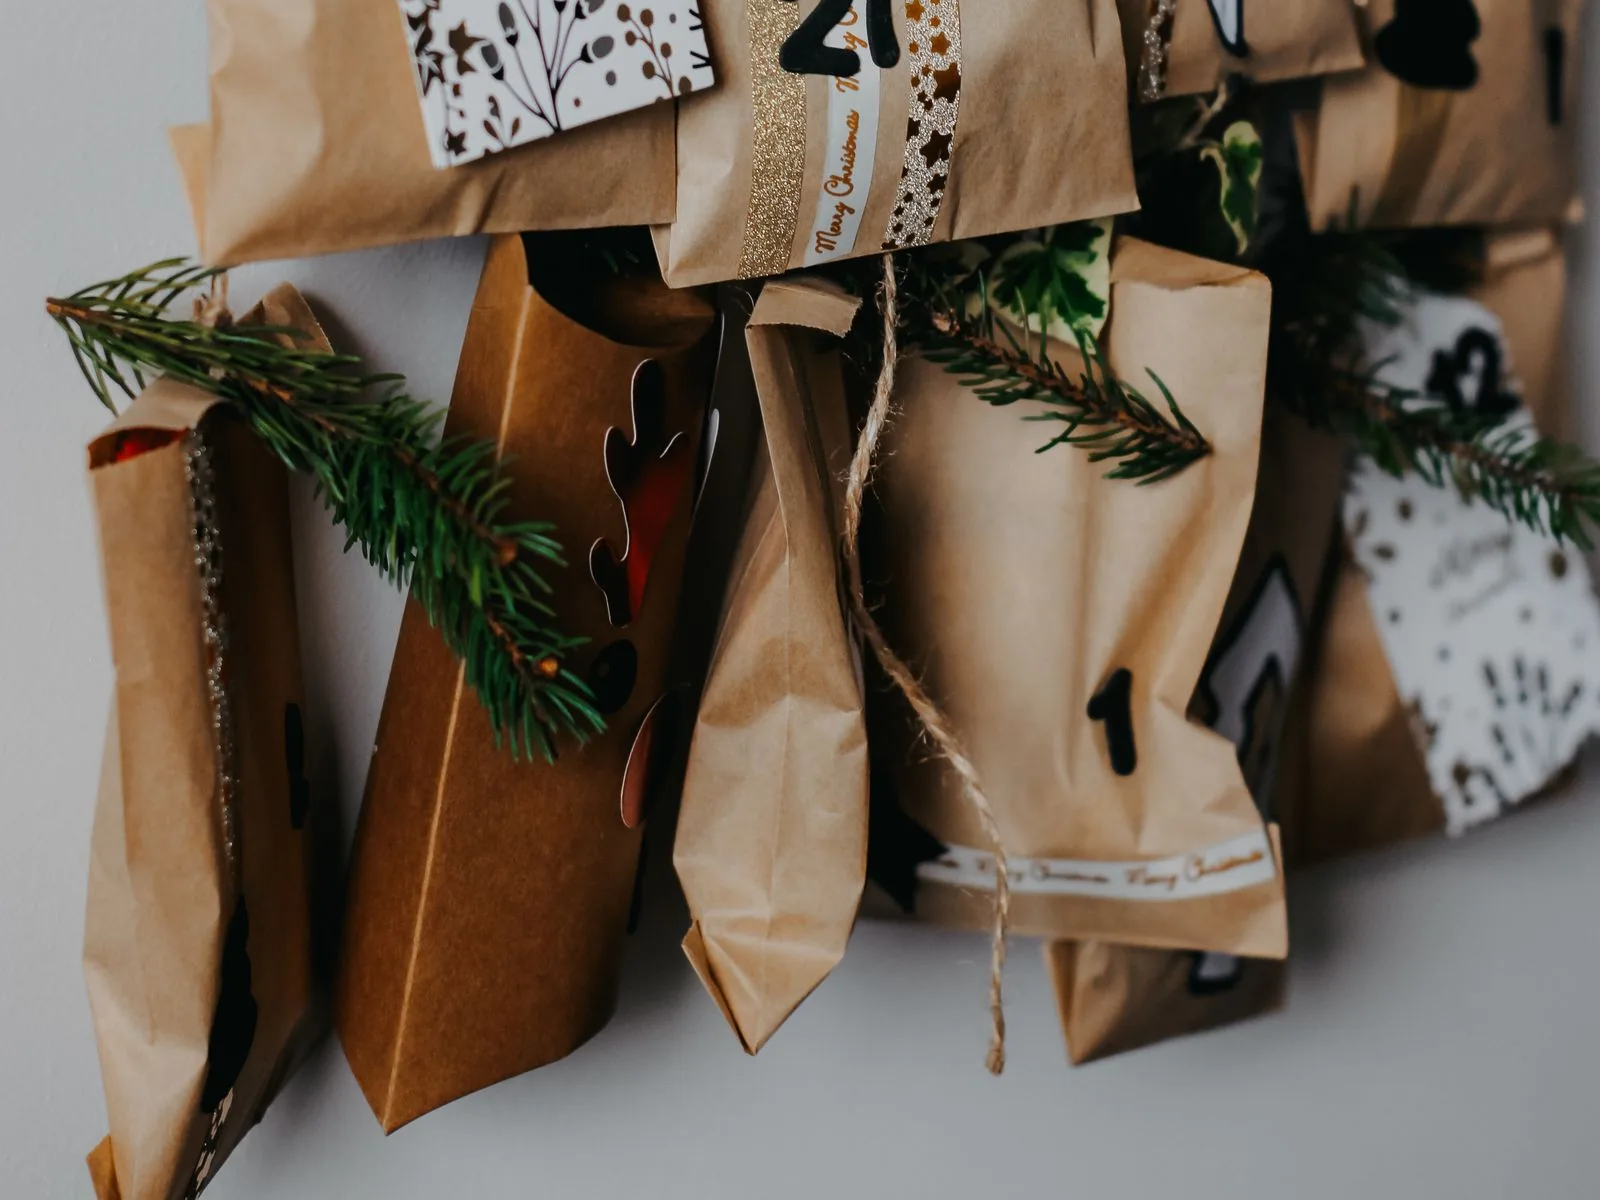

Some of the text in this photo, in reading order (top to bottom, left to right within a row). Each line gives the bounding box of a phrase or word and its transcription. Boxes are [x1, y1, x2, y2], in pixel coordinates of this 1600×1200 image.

[823, 109, 860, 198] Christmas
[814, 201, 856, 254] Merry
[1086, 667, 1137, 776] 1
